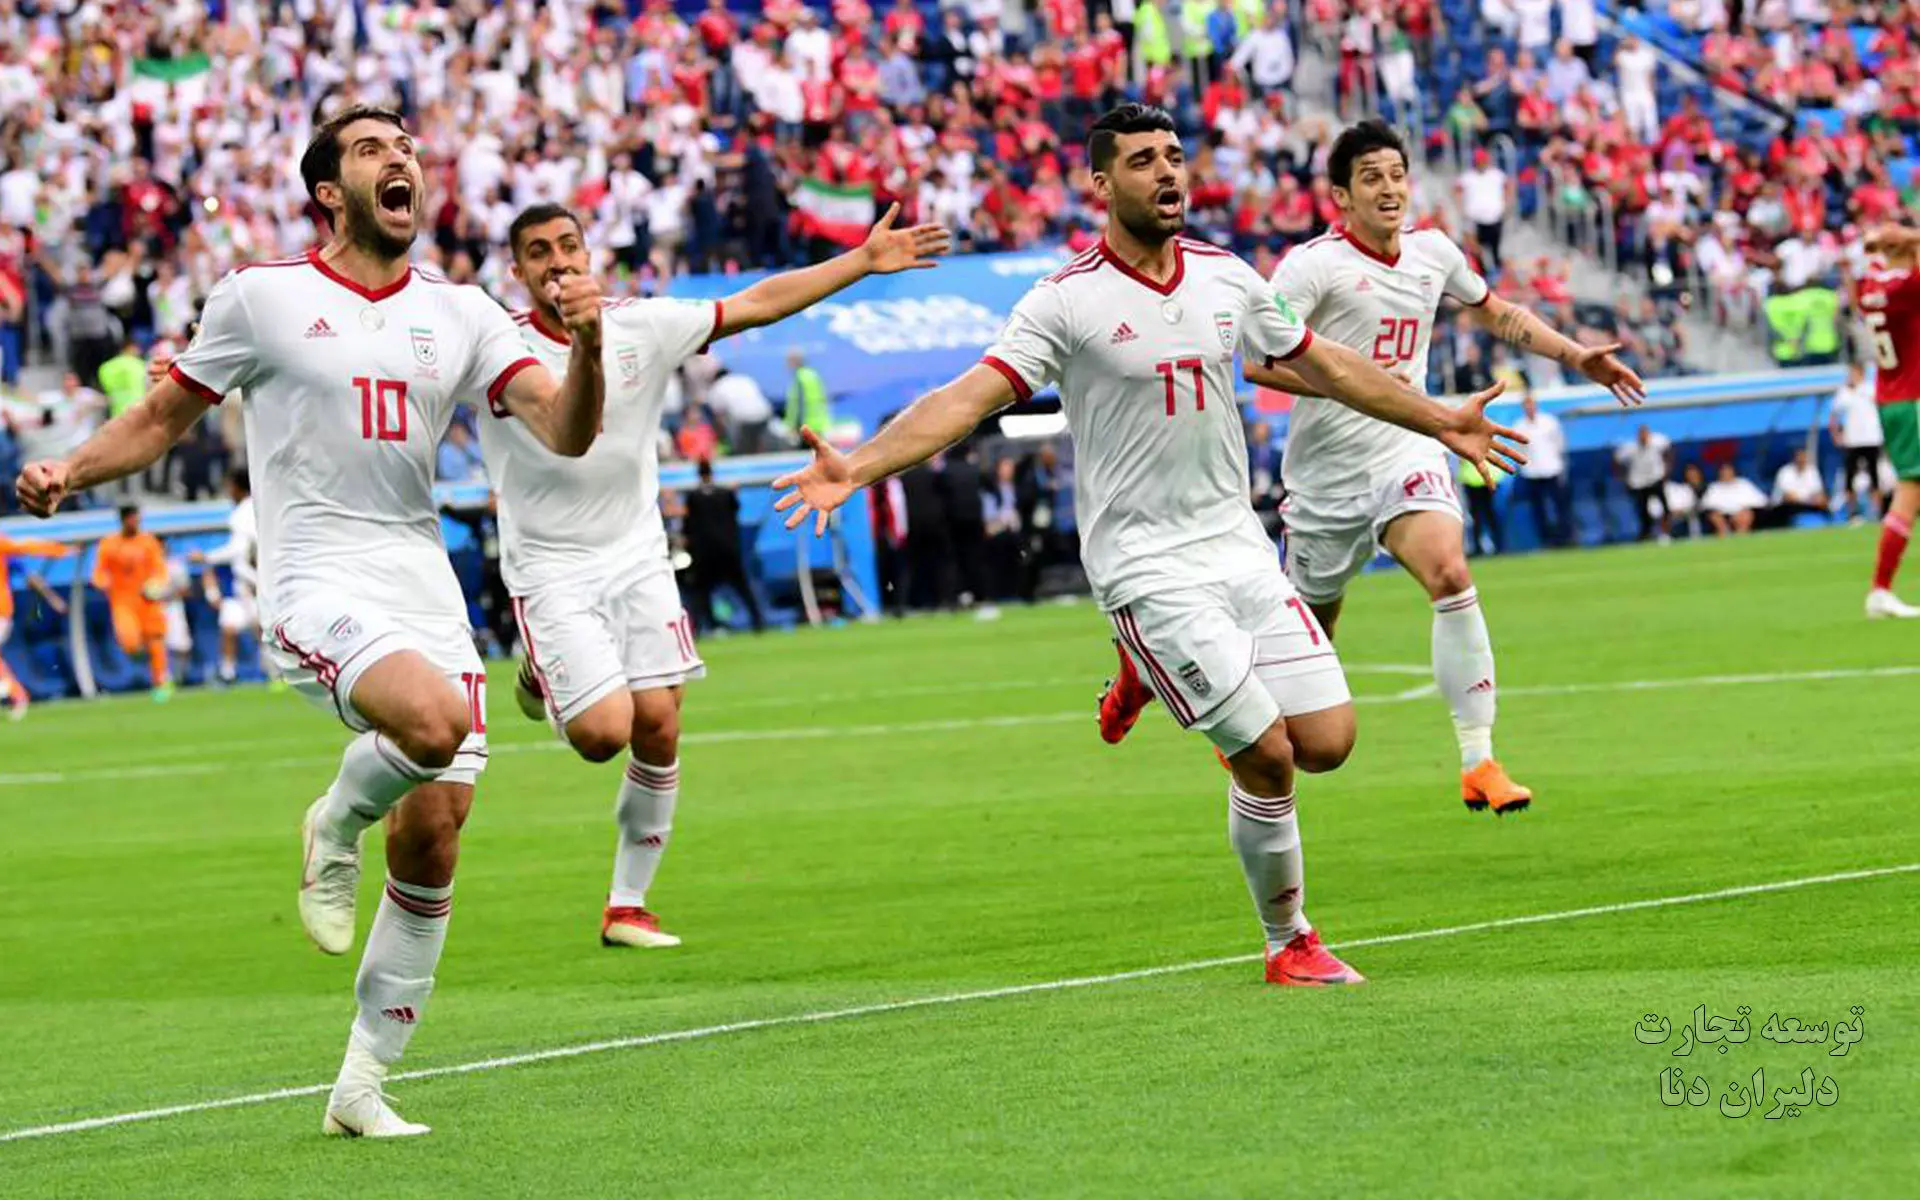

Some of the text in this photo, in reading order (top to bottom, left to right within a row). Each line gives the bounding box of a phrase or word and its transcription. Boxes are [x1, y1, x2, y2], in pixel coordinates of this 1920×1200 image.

[1373, 318, 1419, 361] 20
[352, 377, 408, 441] 10
[1155, 358, 1205, 416] 17
